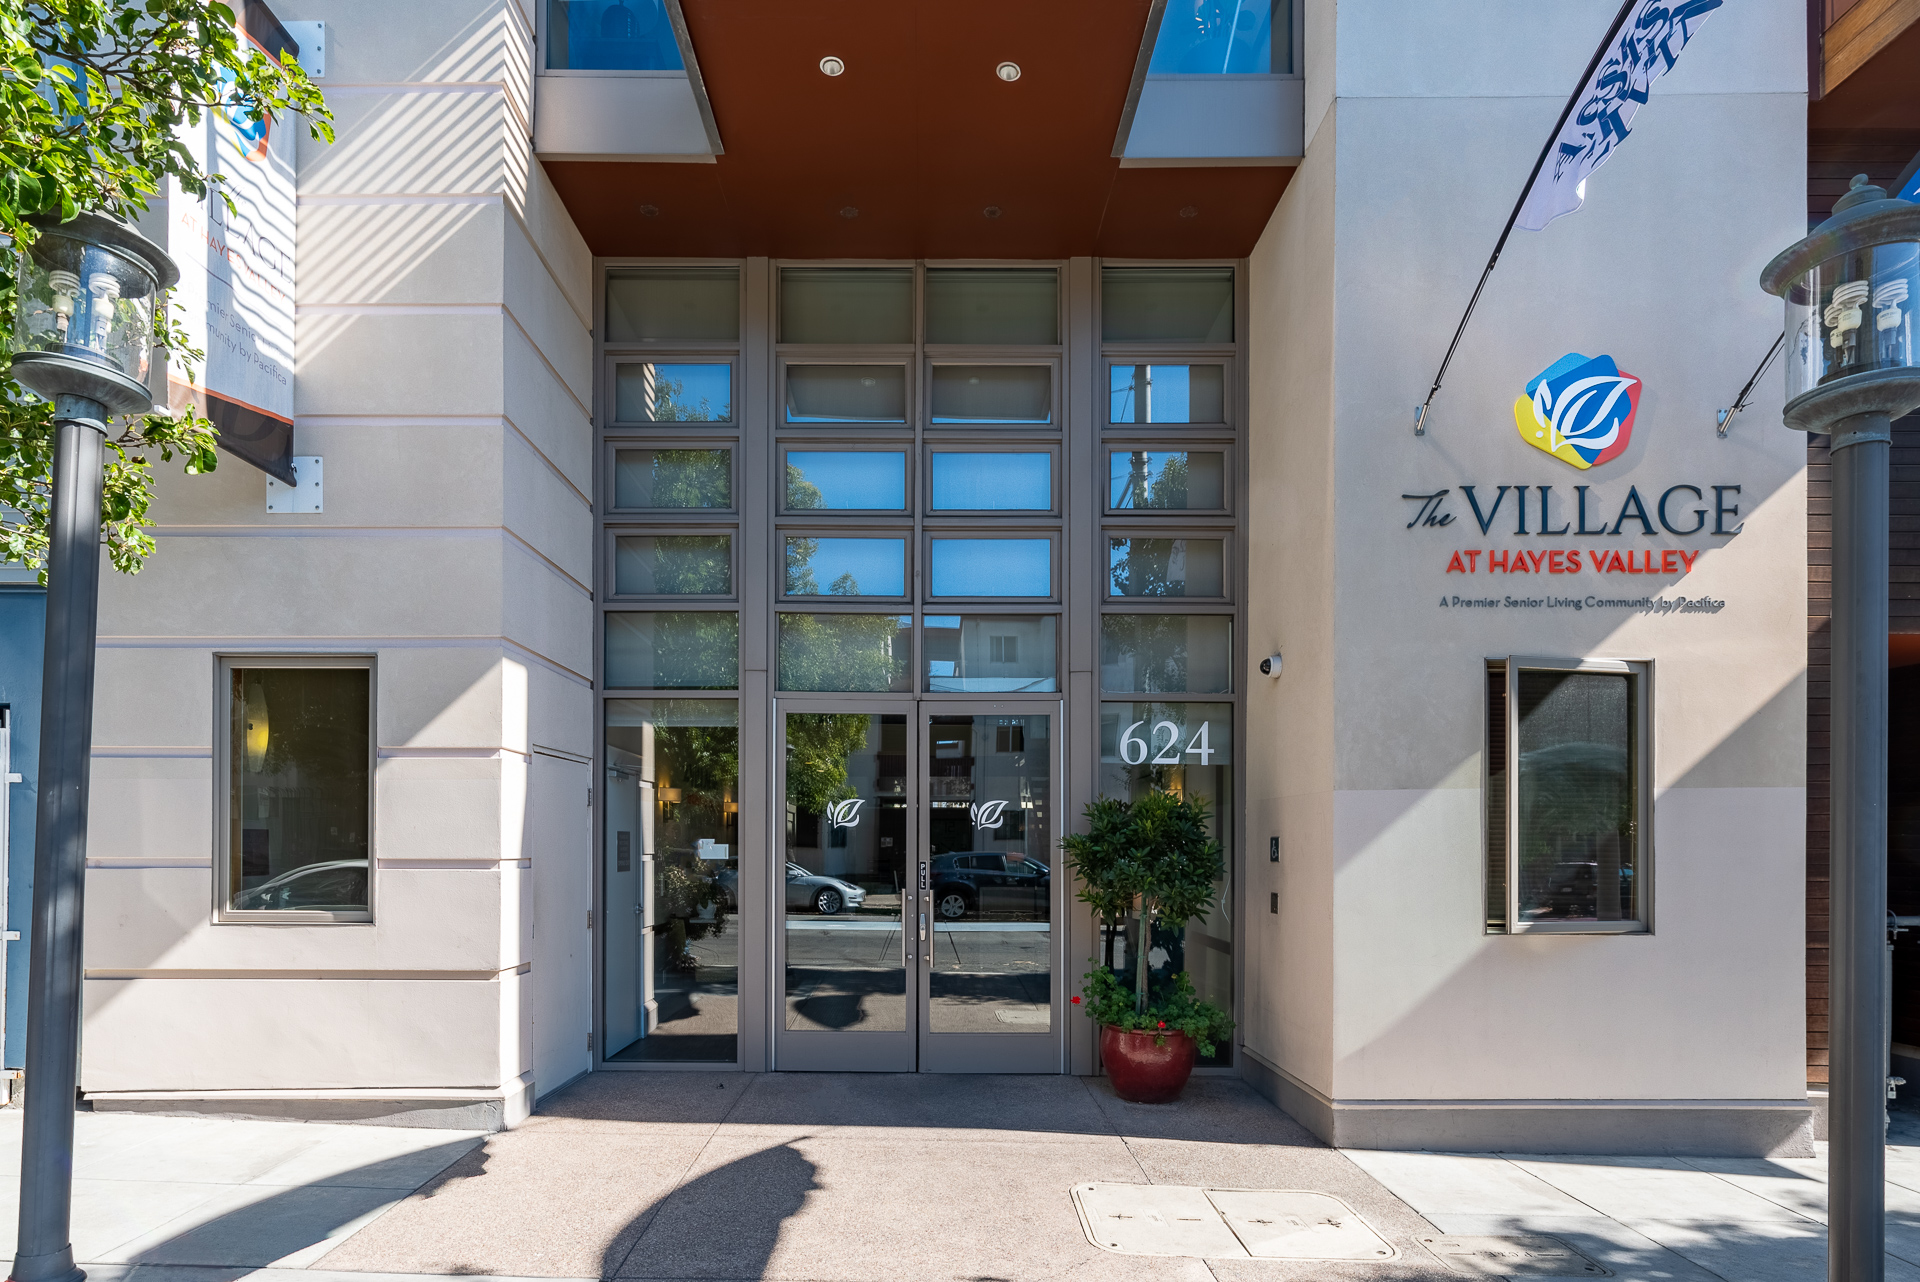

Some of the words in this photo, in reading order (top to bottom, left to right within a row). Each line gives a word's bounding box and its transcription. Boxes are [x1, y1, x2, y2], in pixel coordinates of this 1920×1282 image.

[181, 212, 197, 232] AT
[239, 341, 252, 362] by
[253, 352, 287, 386] Pacifica
[1401, 489, 1457, 529] The
[1458, 484, 1745, 536] VILLAGE
[1446, 550, 1482, 573] AT
[1488, 550, 1582, 573] HAYES
[1588, 550, 1701, 573] VALLEY
[1439, 596, 1449, 608] A
[1452, 595, 1501, 608] Premier
[1503, 595, 1545, 608] Senior
[1547, 596, 1583, 611] Living
[1584, 595, 1656, 611] Community
[1661, 596, 1674, 611] by
[1678, 596, 1726, 609] Pacifica
[1120, 720, 1215, 765] 624
